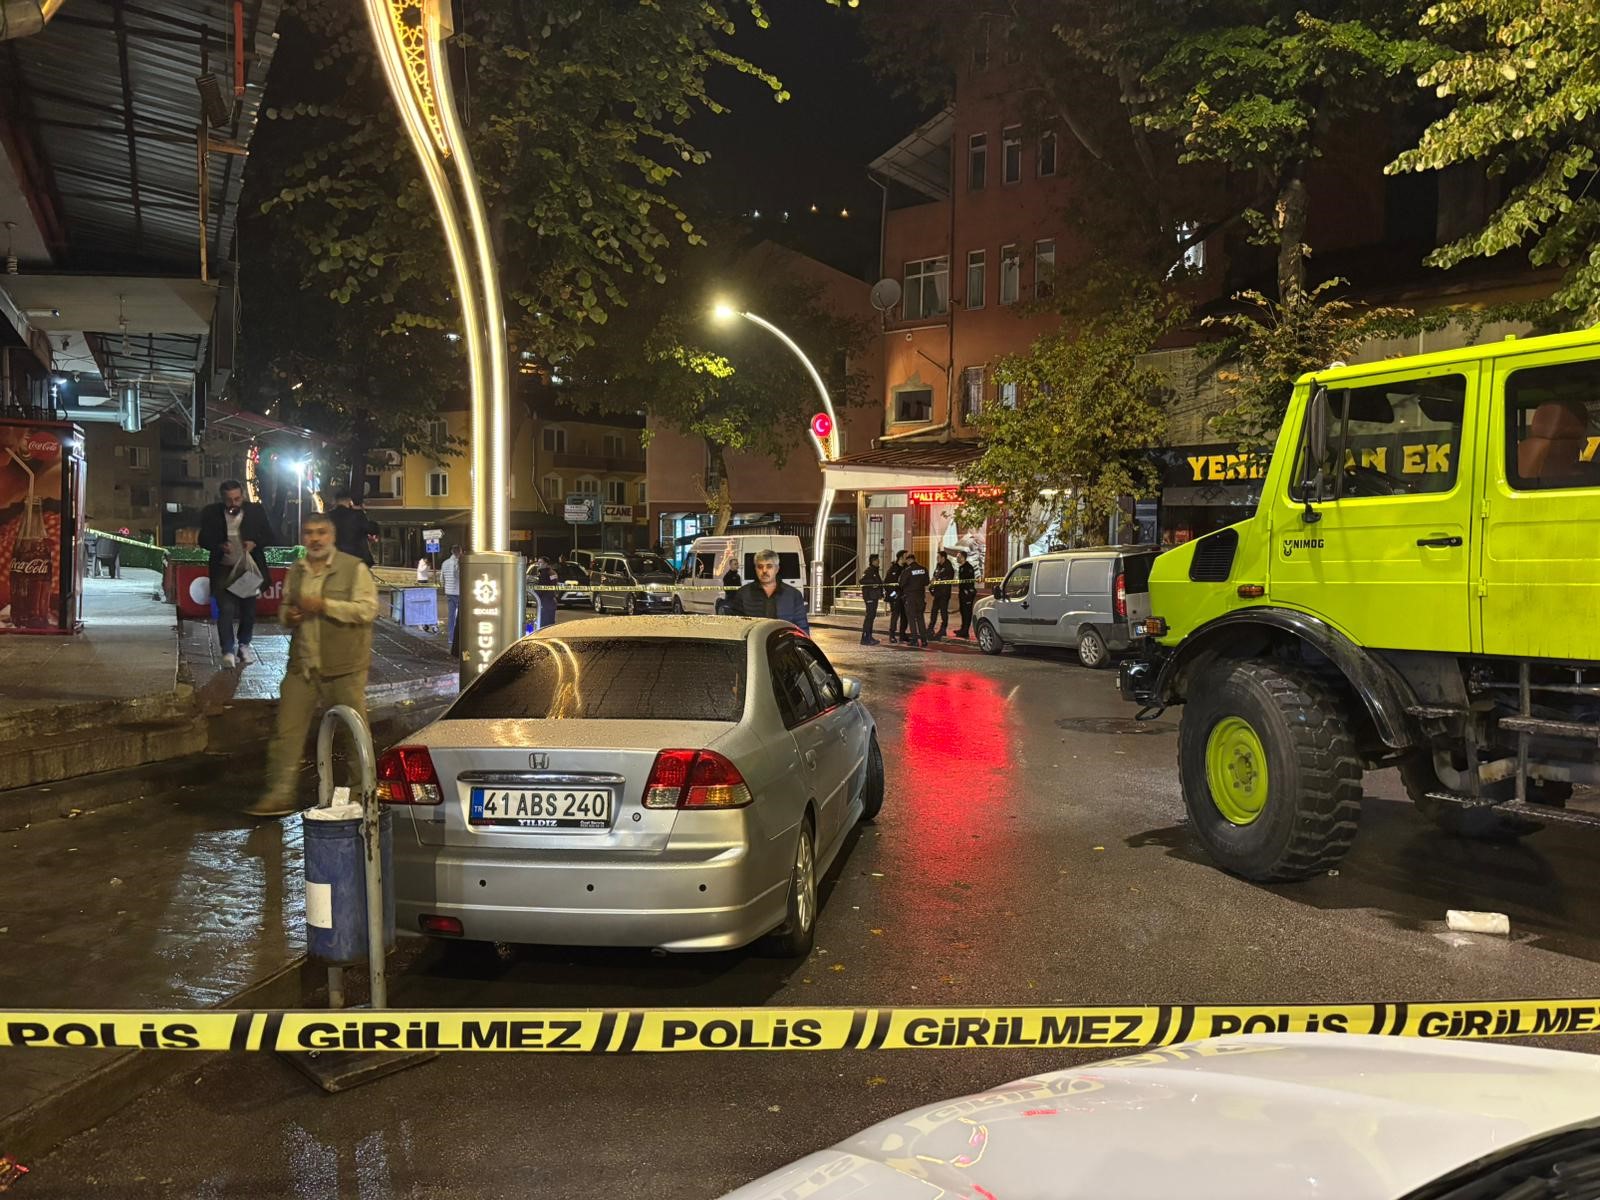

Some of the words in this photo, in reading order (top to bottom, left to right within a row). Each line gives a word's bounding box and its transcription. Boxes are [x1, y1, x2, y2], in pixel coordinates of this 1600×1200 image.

[604, 506, 632, 516] CZANE
[474, 805, 483, 813] TR
[484, 792, 509, 815] 41
[516, 793, 557, 816] ABS
[563, 793, 605, 817] 240
